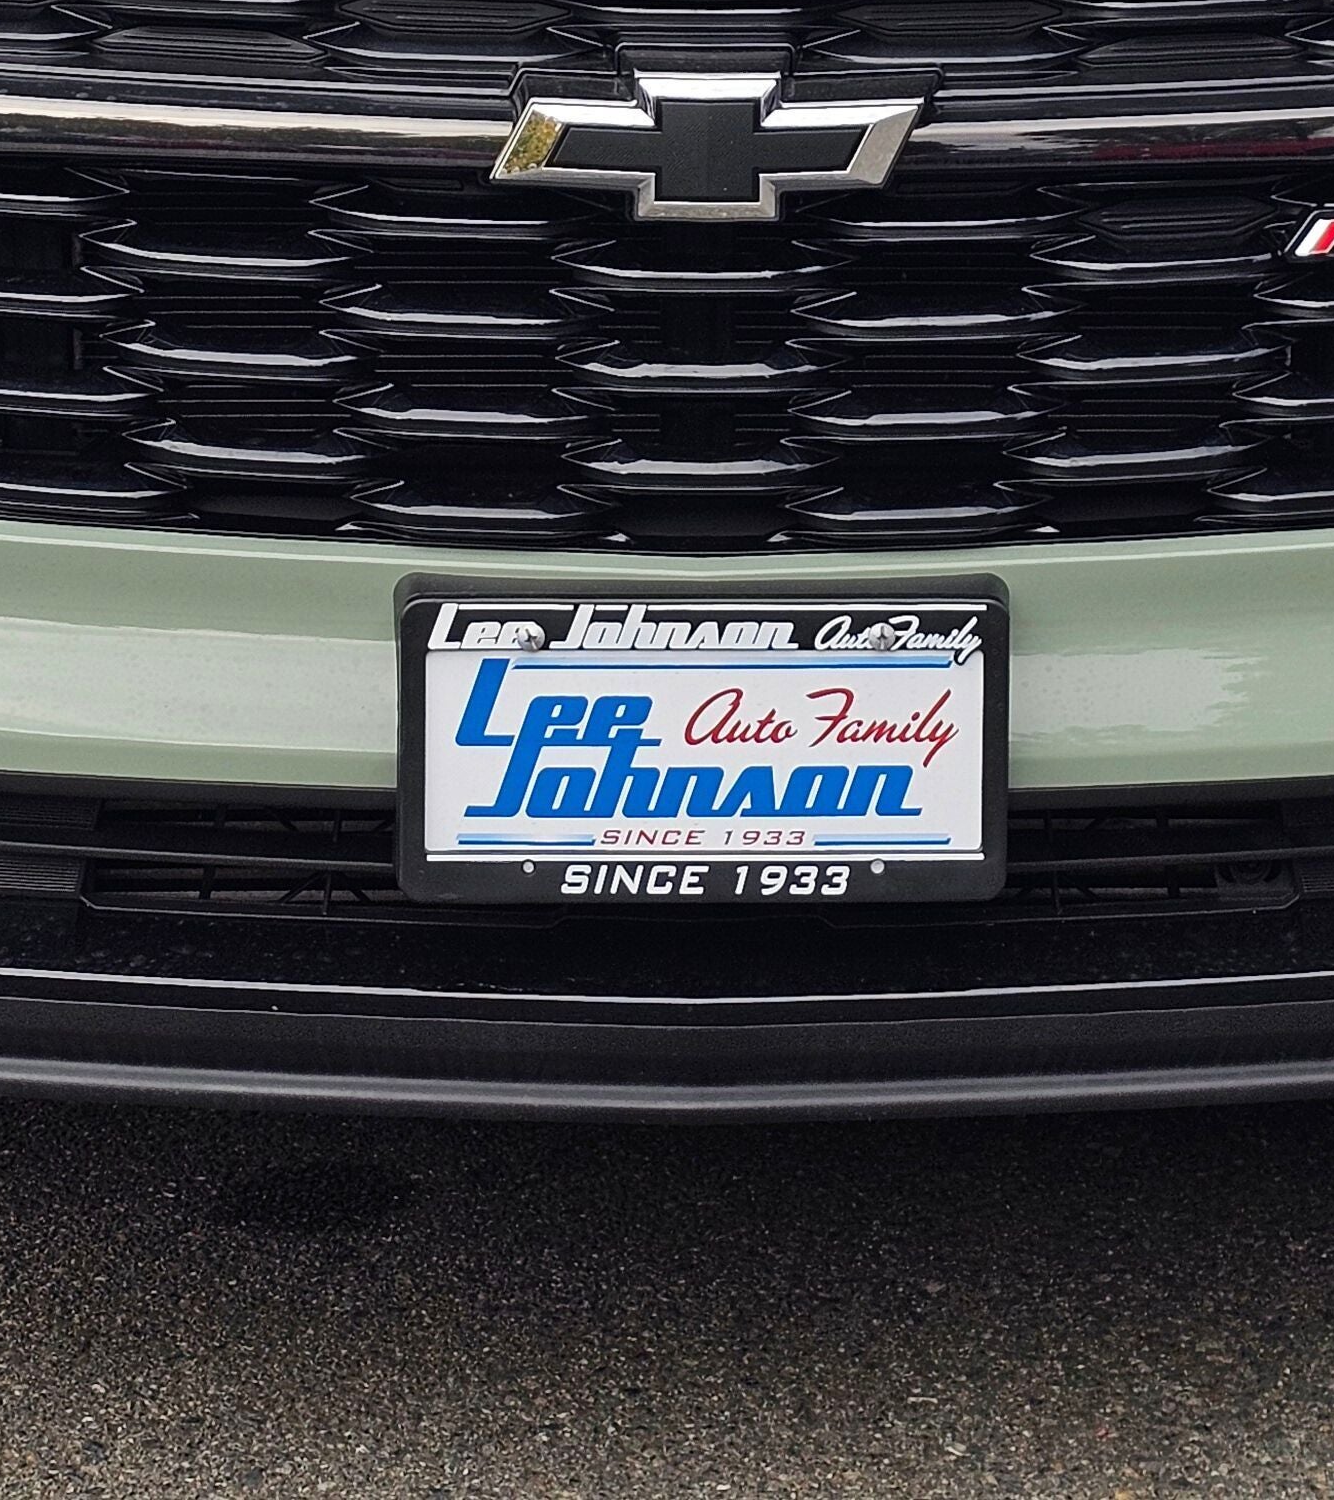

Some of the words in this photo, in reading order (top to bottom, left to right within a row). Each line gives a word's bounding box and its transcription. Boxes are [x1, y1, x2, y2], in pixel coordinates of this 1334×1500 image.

[548, 604, 799, 650] Johnson
[814, 615, 891, 650] Aut
[888, 615, 982, 663] Family
[455, 658, 662, 748] Lee
[684, 688, 799, 747] Auto
[805, 688, 960, 768] Family
[464, 740, 923, 819] Johnson
[600, 829, 707, 846] SINCE
[723, 829, 806, 846] 1933
[560, 864, 710, 895] SINCE
[732, 864, 851, 896] 1933
